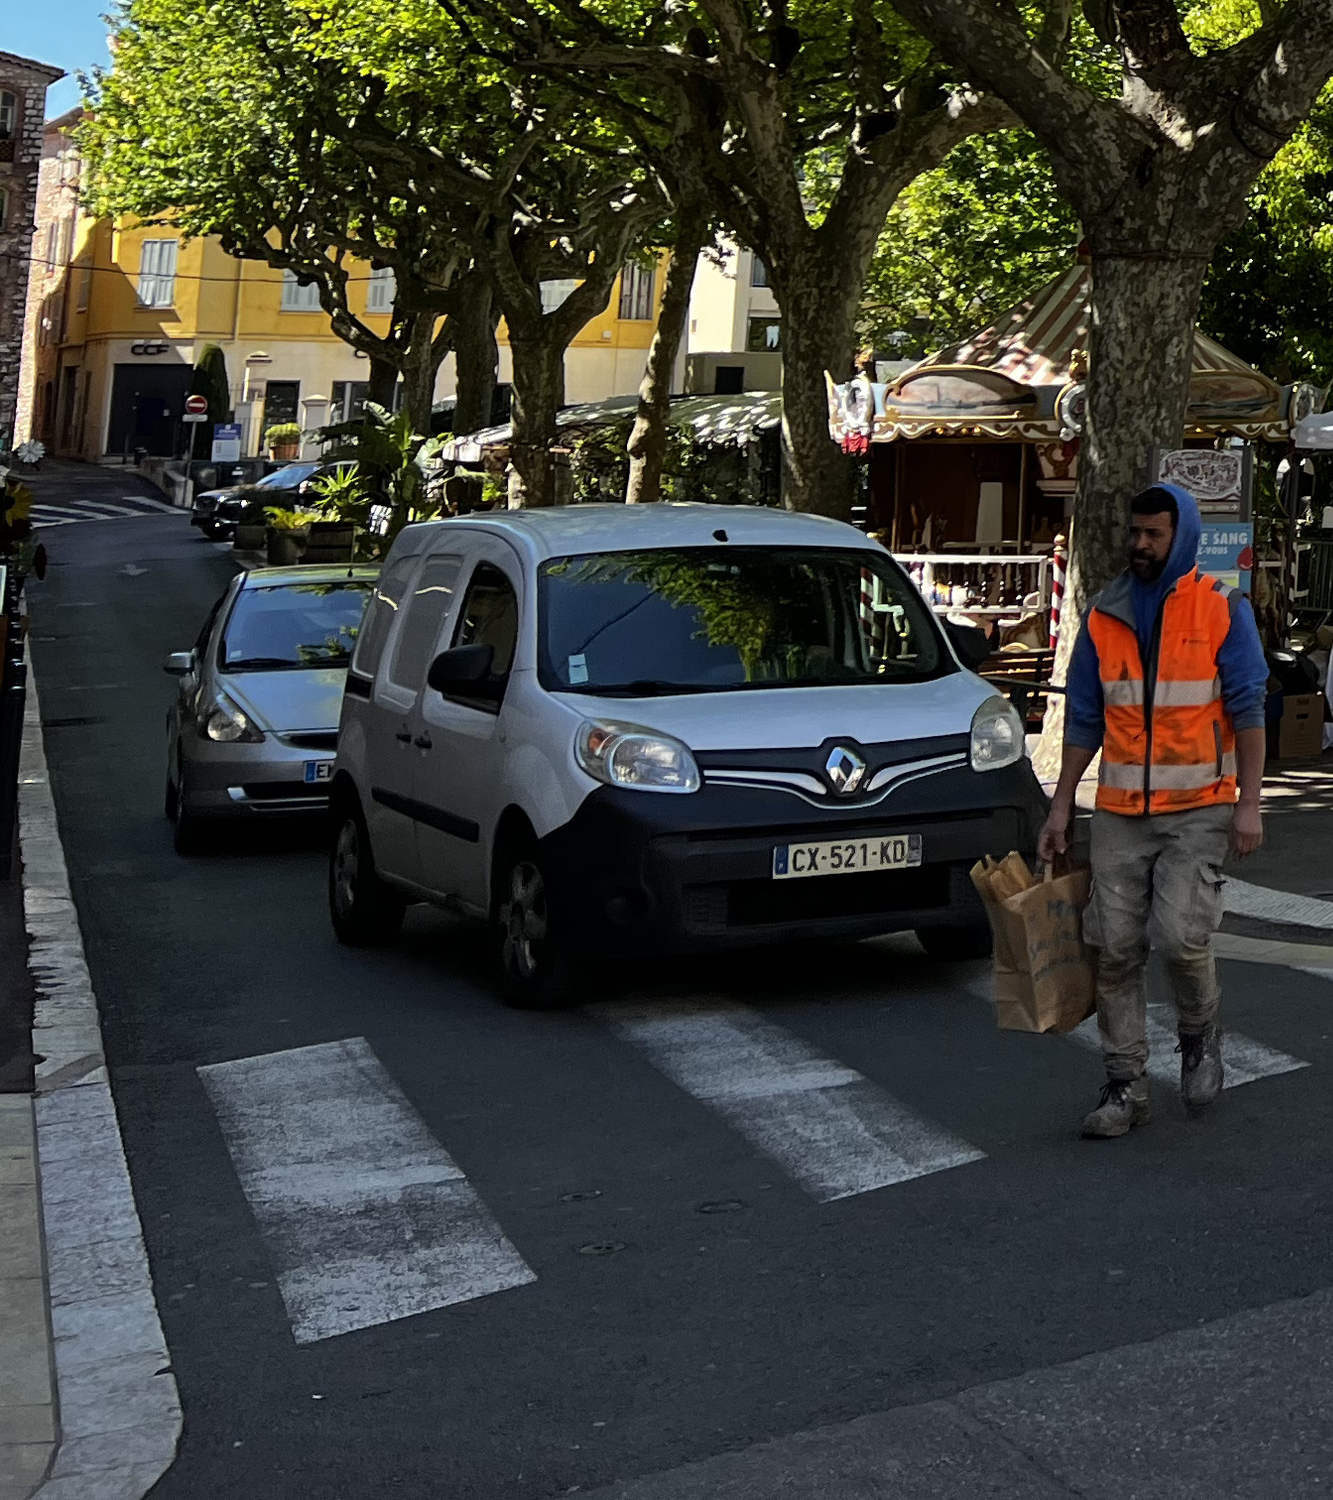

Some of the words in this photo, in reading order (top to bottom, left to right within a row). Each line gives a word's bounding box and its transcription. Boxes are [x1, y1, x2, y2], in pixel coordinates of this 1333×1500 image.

[131, 344, 169, 355] CCF
[1212, 533, 1248, 545] SANG
[792, 840, 905, 872] CX-521-KD
